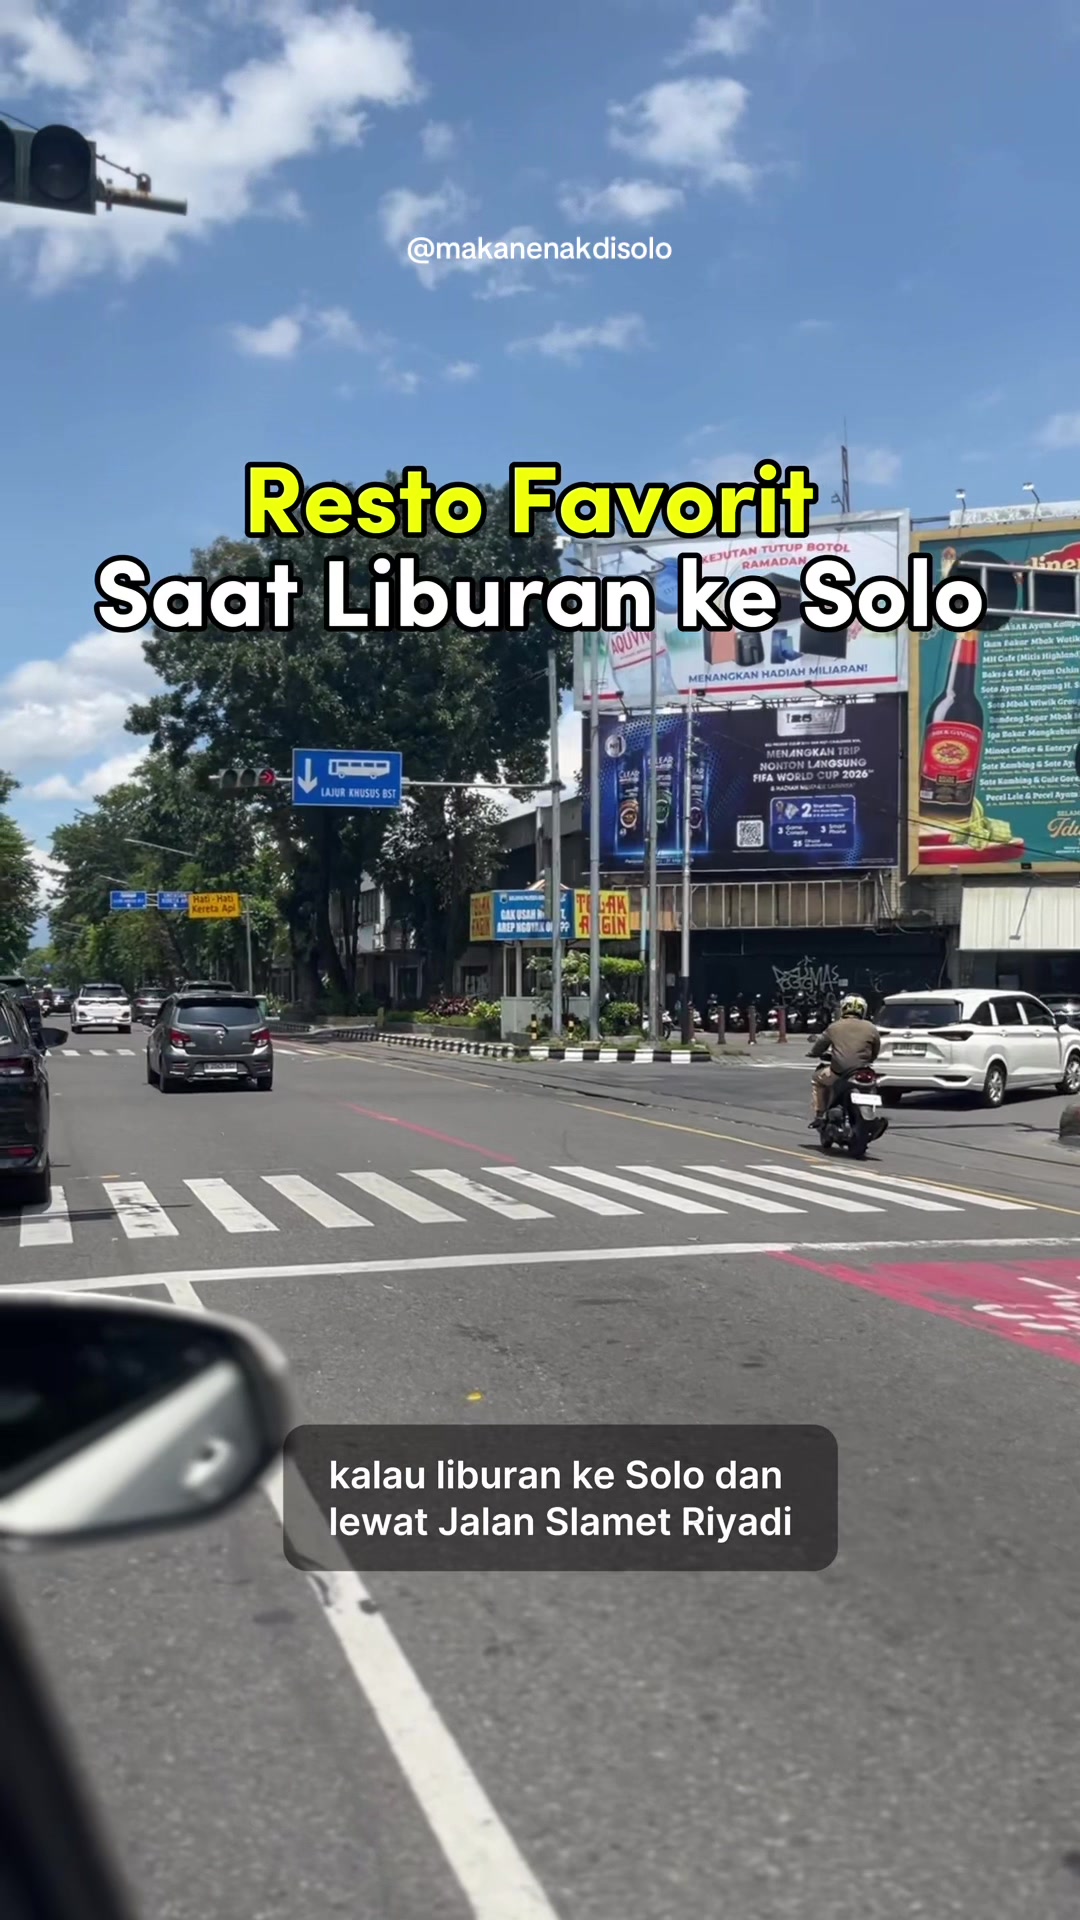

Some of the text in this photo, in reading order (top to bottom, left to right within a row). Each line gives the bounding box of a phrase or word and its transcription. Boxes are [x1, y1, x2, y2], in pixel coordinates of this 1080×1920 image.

[702, 543, 850, 564] KEJUTAN TUTUP BOTOL
[742, 556, 807, 570] RAMADAN
[688, 664, 868, 683] MENANGKAN HADIAH MILIARAN!
[766, 746, 861, 759] MENANGKAN TRIP
[760, 758, 867, 771] NONTON LANGSUNG
[753, 773, 774, 783] FIFA
[777, 771, 814, 782] WORLD
[817, 770, 839, 780] CUP
[321, 787, 396, 799] LAJUR KHUSUS BST
[801, 803, 812, 818] 2
[193, 895, 210, 904] Hati
[216, 894, 233, 903] Hati
[192, 903, 236, 914] Kereta Api
[579, 915, 626, 935] AGIN
